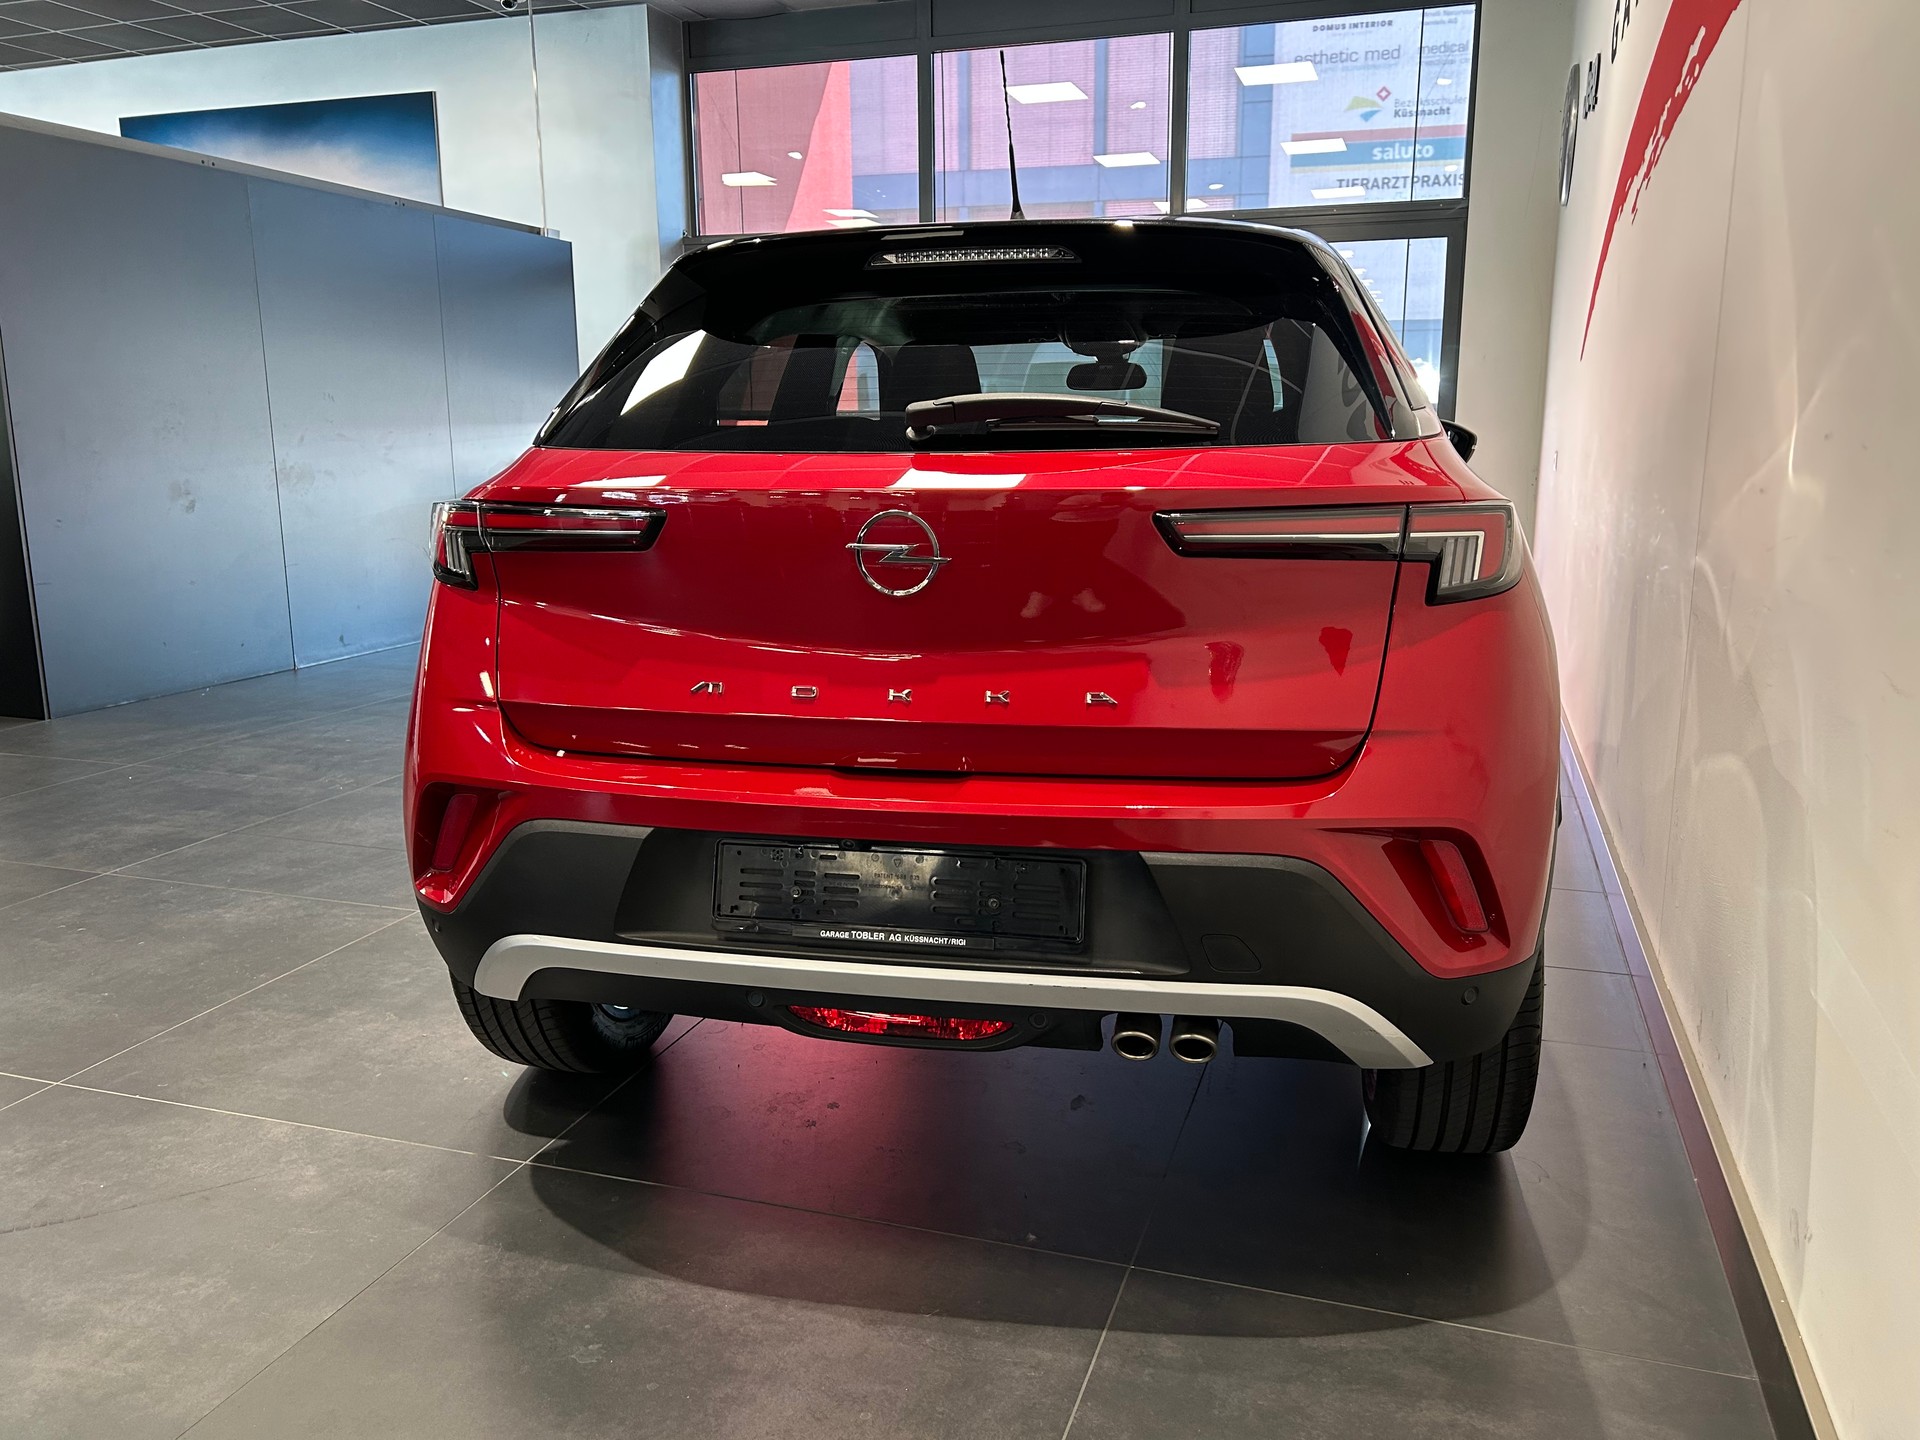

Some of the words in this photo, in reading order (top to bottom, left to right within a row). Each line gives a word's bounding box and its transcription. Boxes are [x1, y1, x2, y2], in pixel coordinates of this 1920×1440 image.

[1312, 23, 1347, 32] DOMUS
[1349, 20, 1394, 30] INTERIOR
[1294, 48, 1360, 65] esthetic
[1364, 44, 1401, 61] med
[1372, 142, 1435, 160] saluto
[690, 681, 1118, 704] MOKKA
[820, 930, 849, 939] GARAGE
[850, 930, 885, 941] TOBLER
[888, 933, 902, 942] AG
[904, 934, 966, 946] KÜSSNACHT/RIGI
